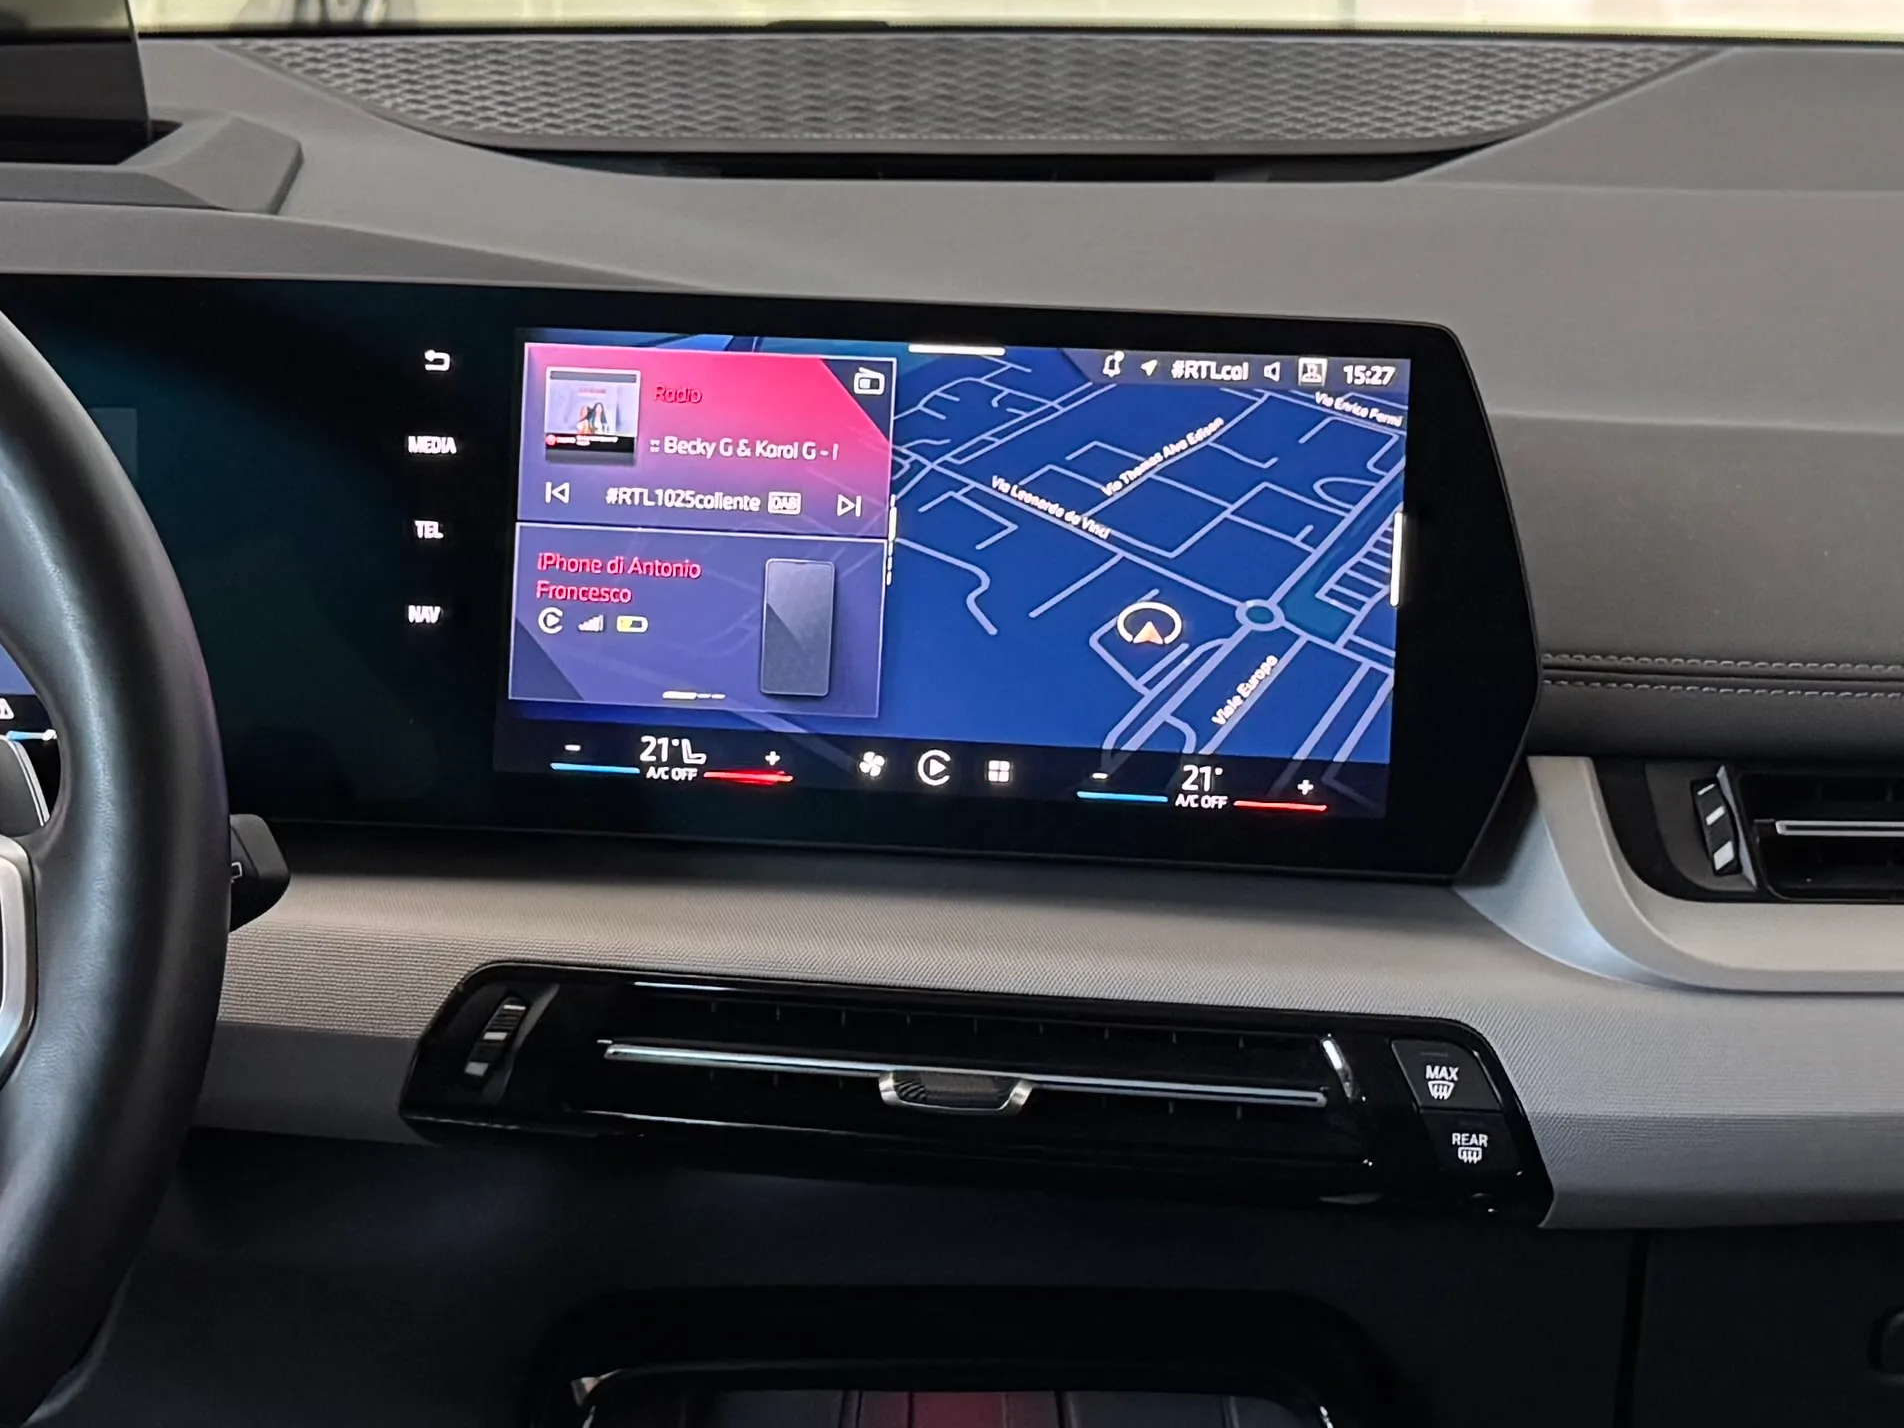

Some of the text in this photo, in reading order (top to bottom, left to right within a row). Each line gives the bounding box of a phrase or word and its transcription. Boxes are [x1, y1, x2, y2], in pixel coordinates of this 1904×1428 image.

[1343, 364, 1396, 386] 15:27
[652, 384, 704, 405] Radio
[408, 436, 457, 454] MEDIA
[664, 436, 716, 460] Becky
[719, 438, 733, 457] G
[737, 439, 752, 458] &
[802, 442, 817, 461] G
[415, 520, 444, 539] TEL
[537, 552, 702, 580] iPhone di Antonio
[408, 605, 441, 624] NAV
[671, 767, 698, 781] OFF
[1200, 795, 1228, 809] OFF
[1425, 1064, 1459, 1081] MAX
[1451, 1132, 1488, 1147] REAR
